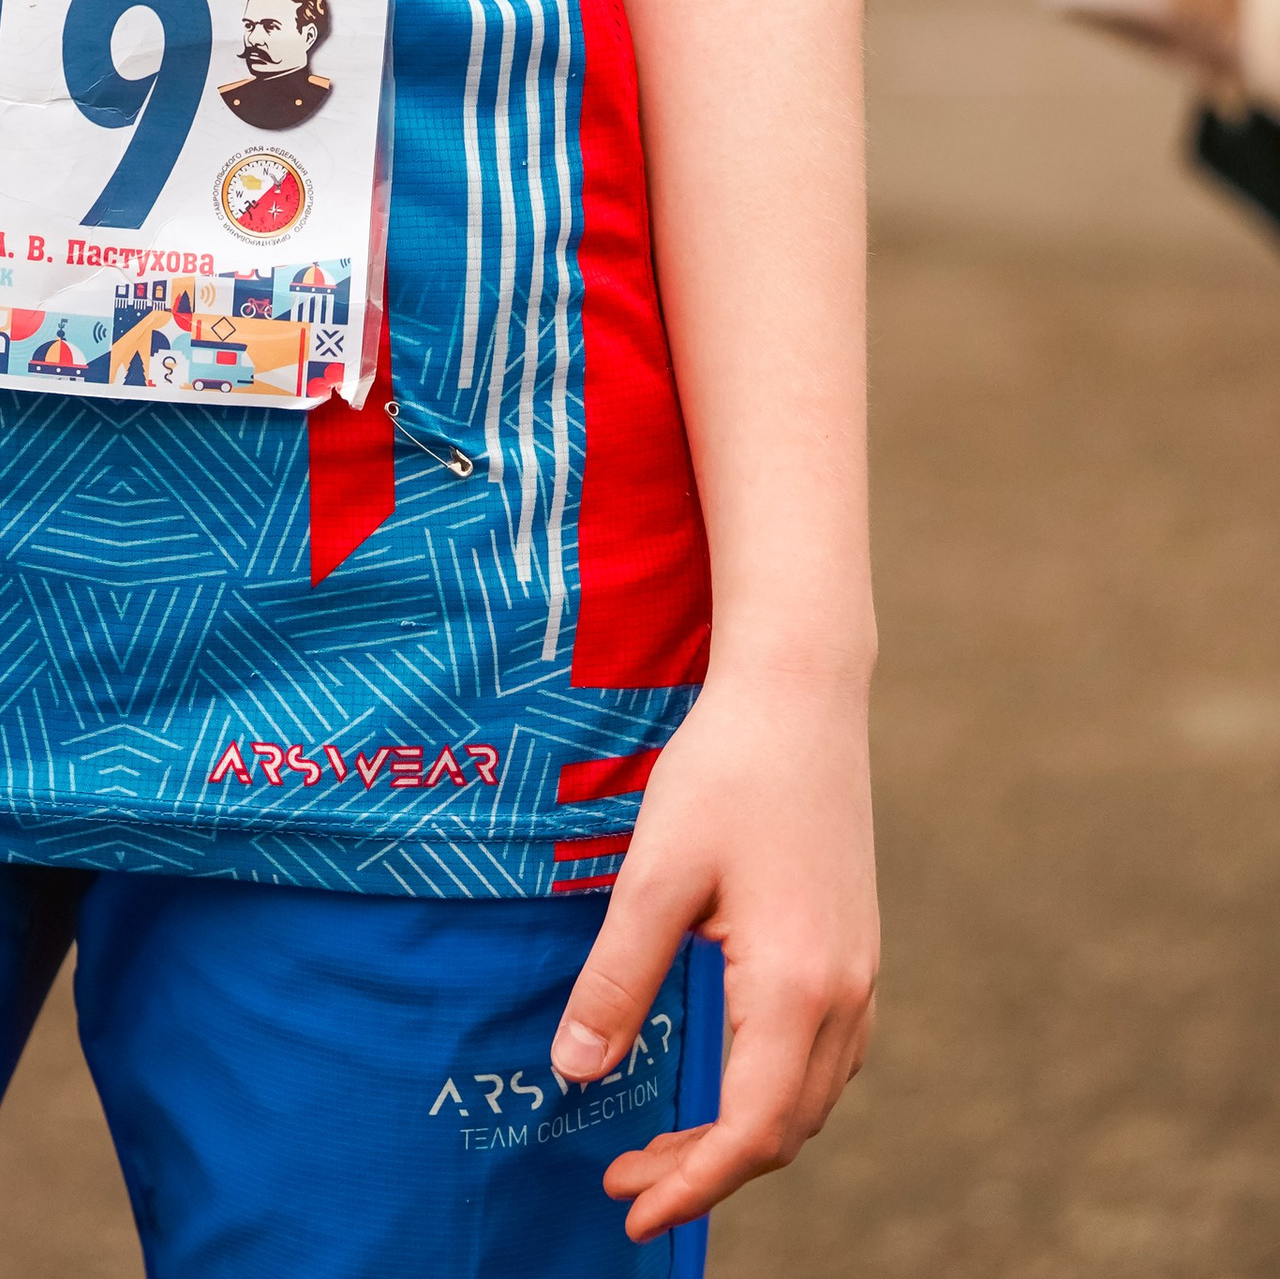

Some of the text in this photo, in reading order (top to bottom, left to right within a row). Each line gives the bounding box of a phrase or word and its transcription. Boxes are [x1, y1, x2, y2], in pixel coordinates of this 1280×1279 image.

[244, 146, 264, 155] КРАЯ
[27, 235, 53, 263] В.
[66, 238, 215, 278] Пастухова
[209, 740, 500, 790] ARSWEAR
[428, 1013, 672, 1118] ARSAR
[460, 1076, 660, 1151] TEAM COLLECTION
